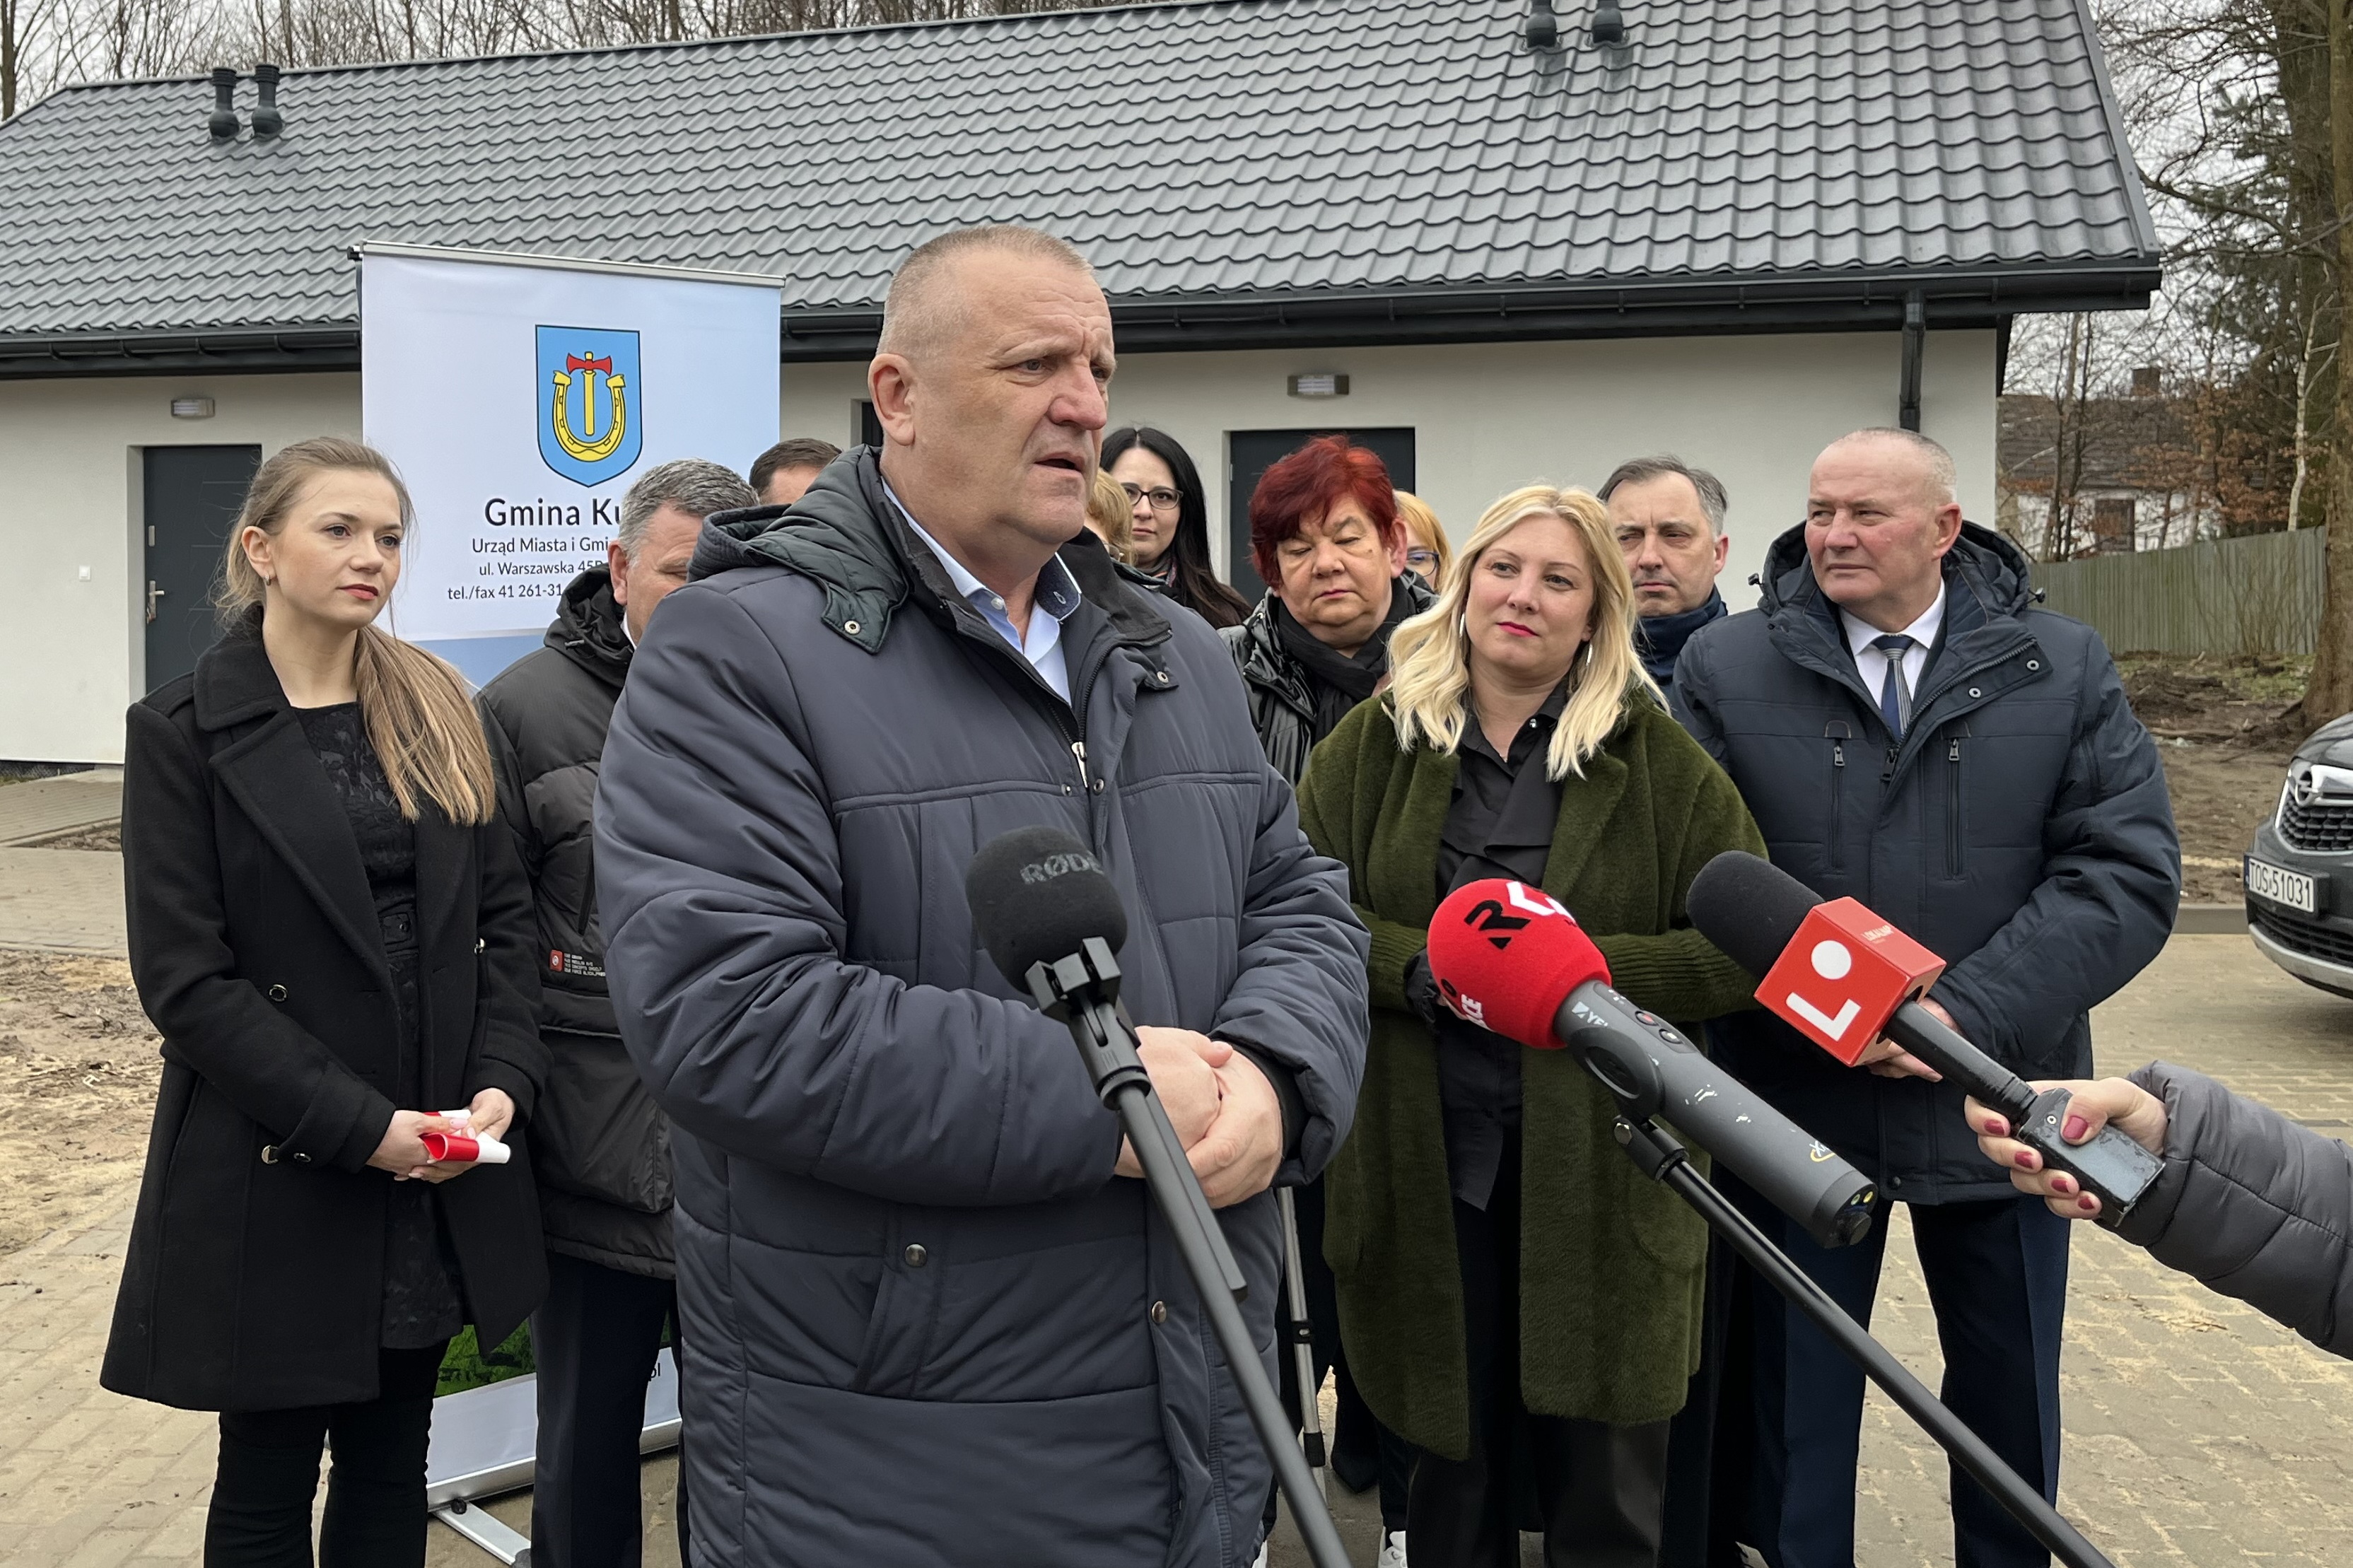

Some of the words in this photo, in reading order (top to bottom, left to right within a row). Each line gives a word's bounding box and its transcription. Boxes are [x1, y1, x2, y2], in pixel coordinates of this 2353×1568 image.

[485, 498, 580, 526] Gmina
[472, 537, 515, 556] Urząd
[520, 537, 566, 552] Miasta
[571, 537, 575, 551] i
[479, 562, 494, 575] ul.
[498, 561, 574, 575] Warszawska
[448, 586, 495, 599] tel./fax
[498, 585, 514, 598] 41
[2250, 862, 2268, 893] TOS
[2272, 870, 2310, 908] 51031
